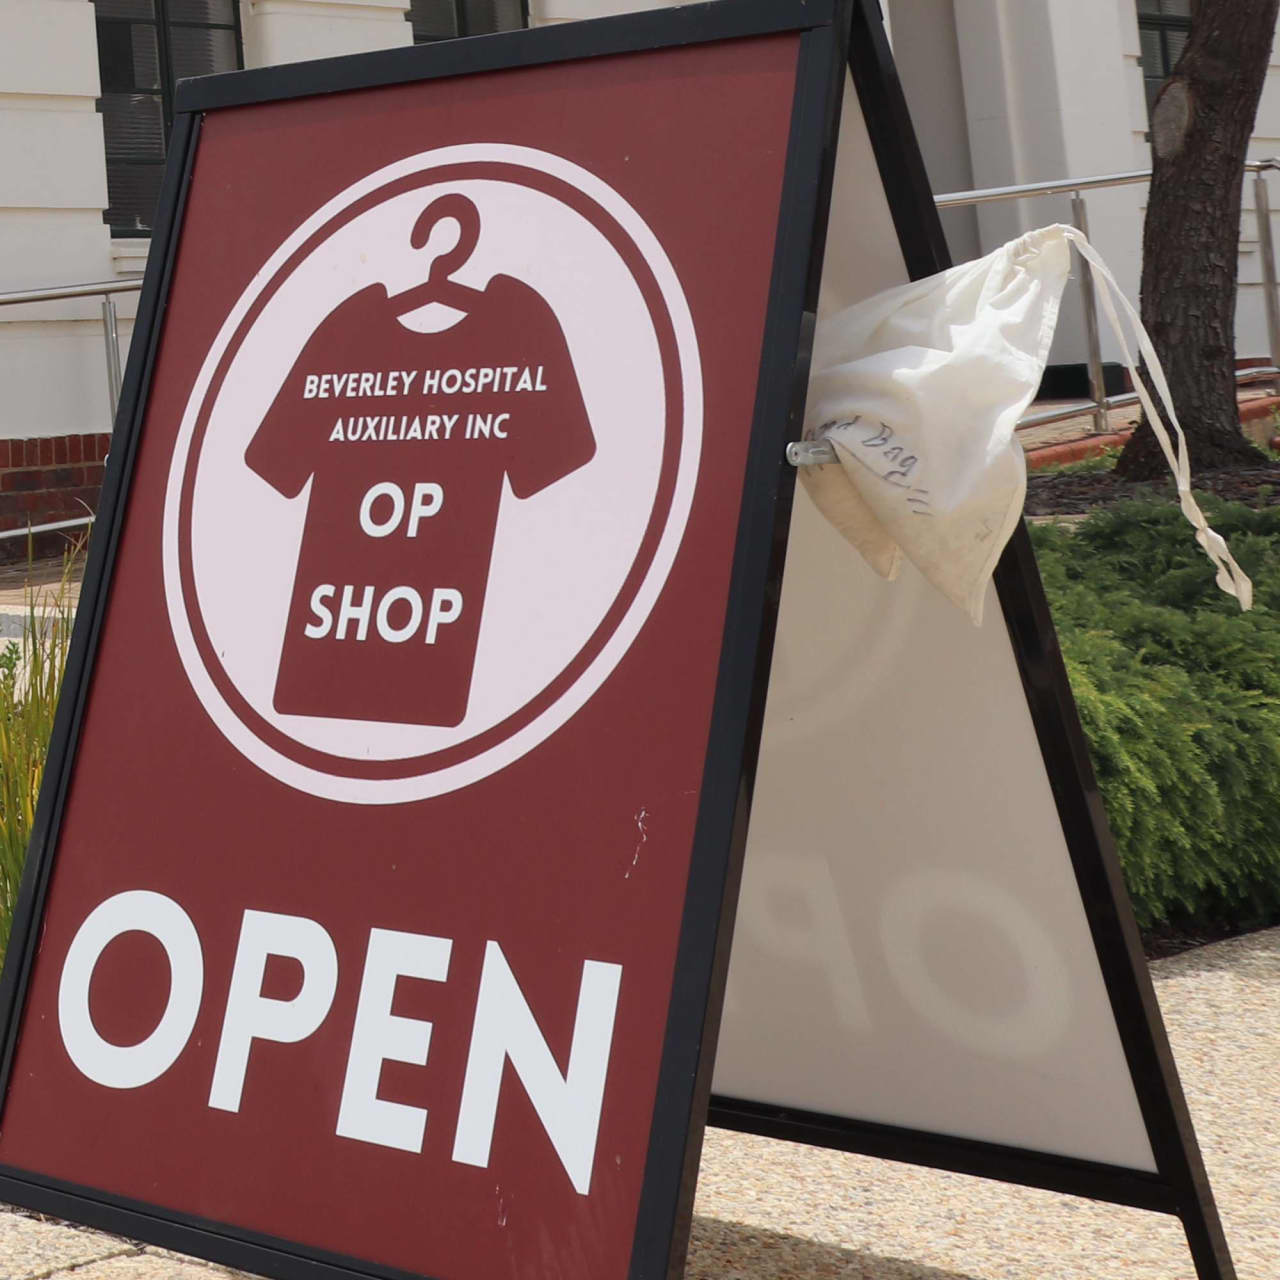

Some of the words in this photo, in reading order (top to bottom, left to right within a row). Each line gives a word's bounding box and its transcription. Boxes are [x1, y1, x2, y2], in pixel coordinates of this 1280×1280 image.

[303, 370, 418, 399] BEVERLEY
[422, 366, 547, 395] HOSPITAL
[328, 414, 460, 442] AUXILIARY
[464, 413, 511, 440] INC
[359, 481, 444, 538] OP
[304, 583, 464, 645] SHOP
[57, 889, 624, 1197] OPEN
